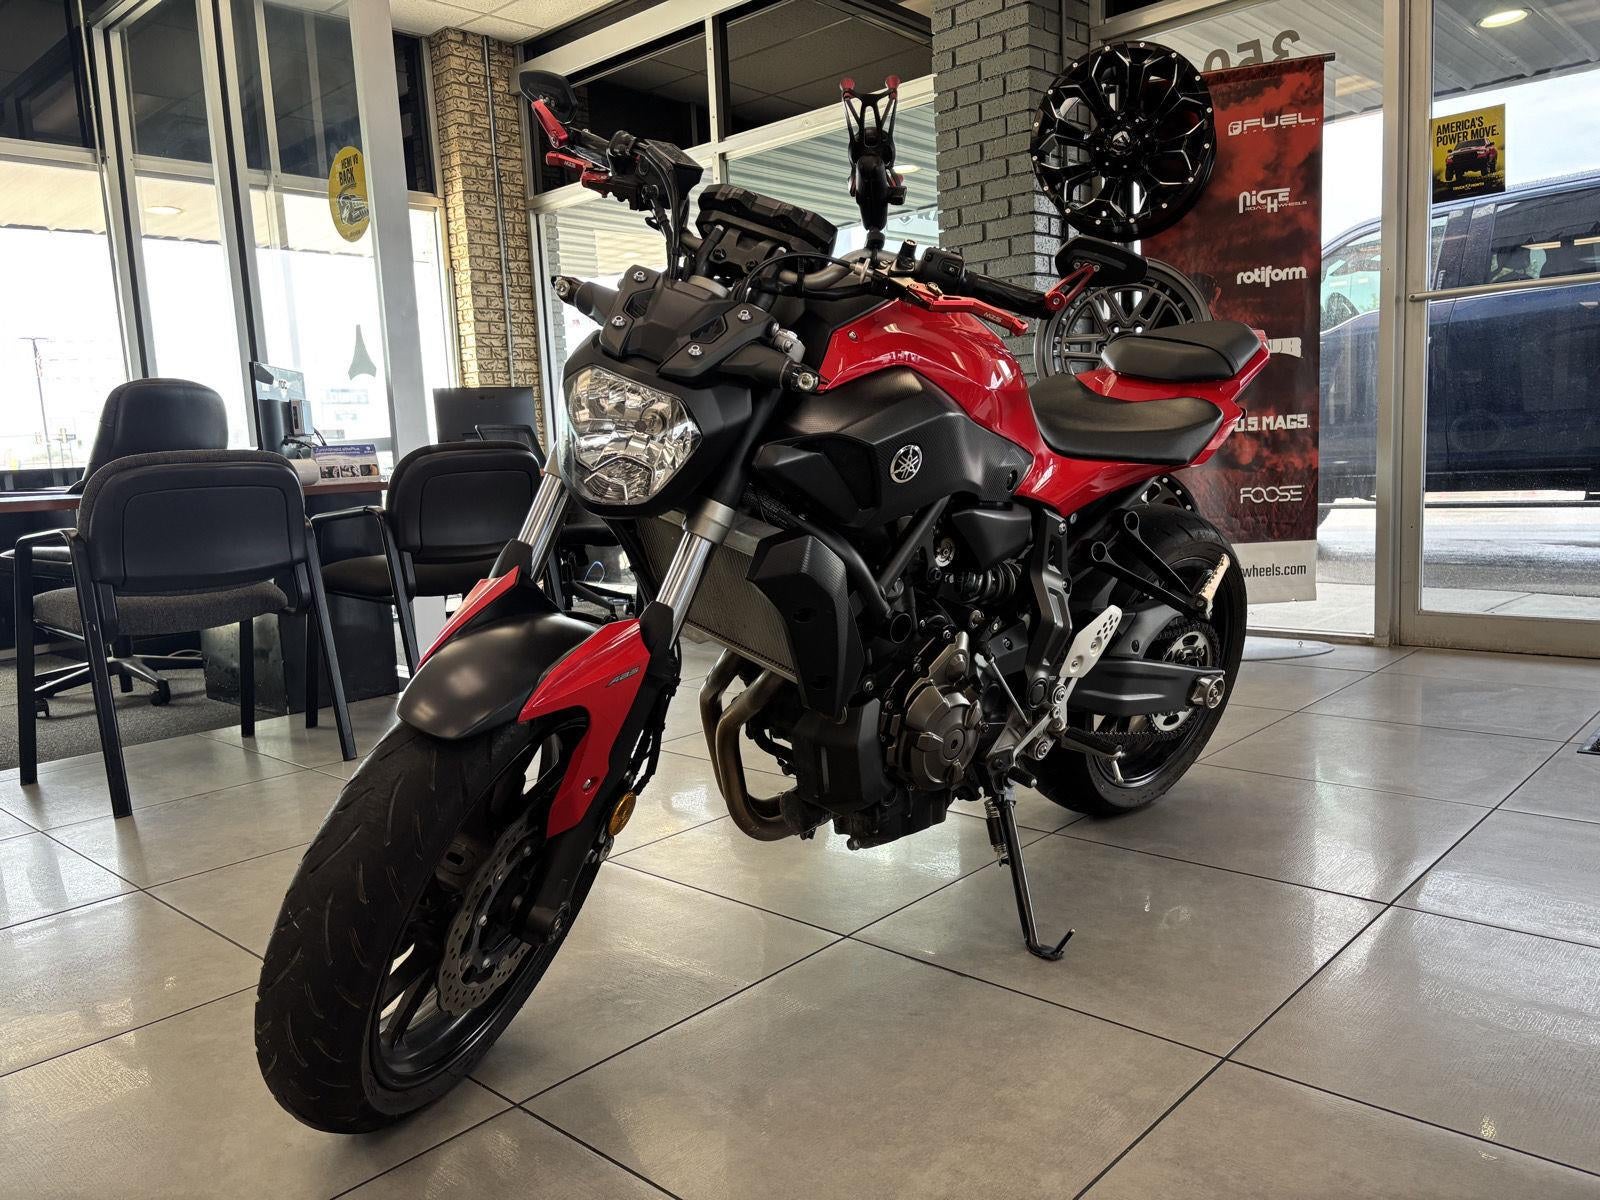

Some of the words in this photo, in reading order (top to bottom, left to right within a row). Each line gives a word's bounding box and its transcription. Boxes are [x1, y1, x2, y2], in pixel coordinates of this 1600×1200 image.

[1243, 112, 1316, 131] FUEL
[1436, 116, 1484, 136] AMERICA'S
[1436, 130, 1468, 147] POWER
[1471, 124, 1500, 141] MOVE.
[338, 167, 355, 186] BACK
[1237, 265, 1307, 287] rotiform
[1240, 485, 1303, 504] FOOSE
[1240, 563, 1307, 578] wheels.com
